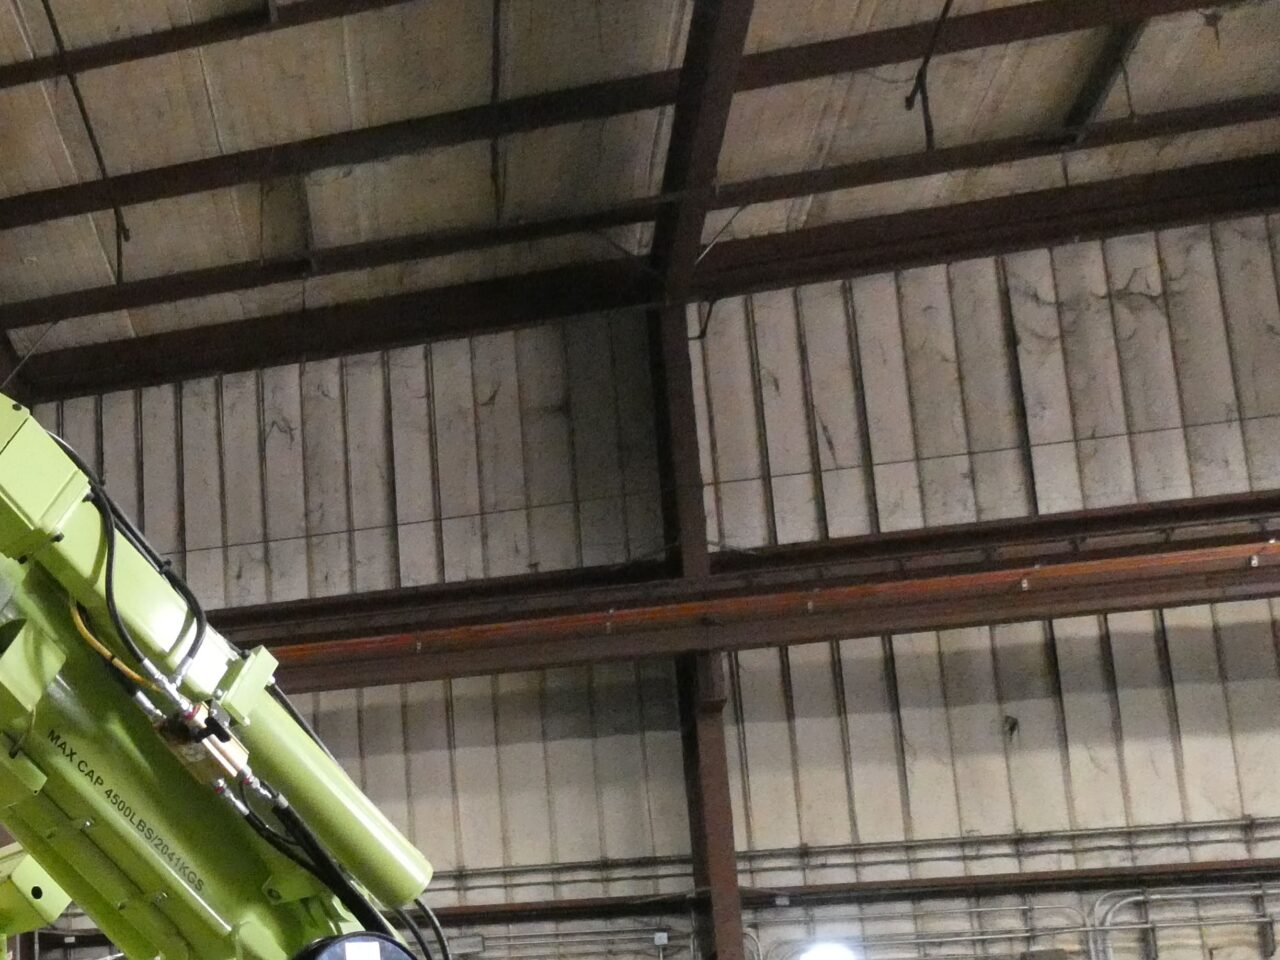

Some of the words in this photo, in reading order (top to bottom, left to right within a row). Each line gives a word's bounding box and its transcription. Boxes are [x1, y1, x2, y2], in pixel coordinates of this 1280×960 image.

[47, 729, 77, 763] MAX
[77, 760, 104, 787] CAP
[105, 788, 205, 892] 4500LBS/2041KGS
